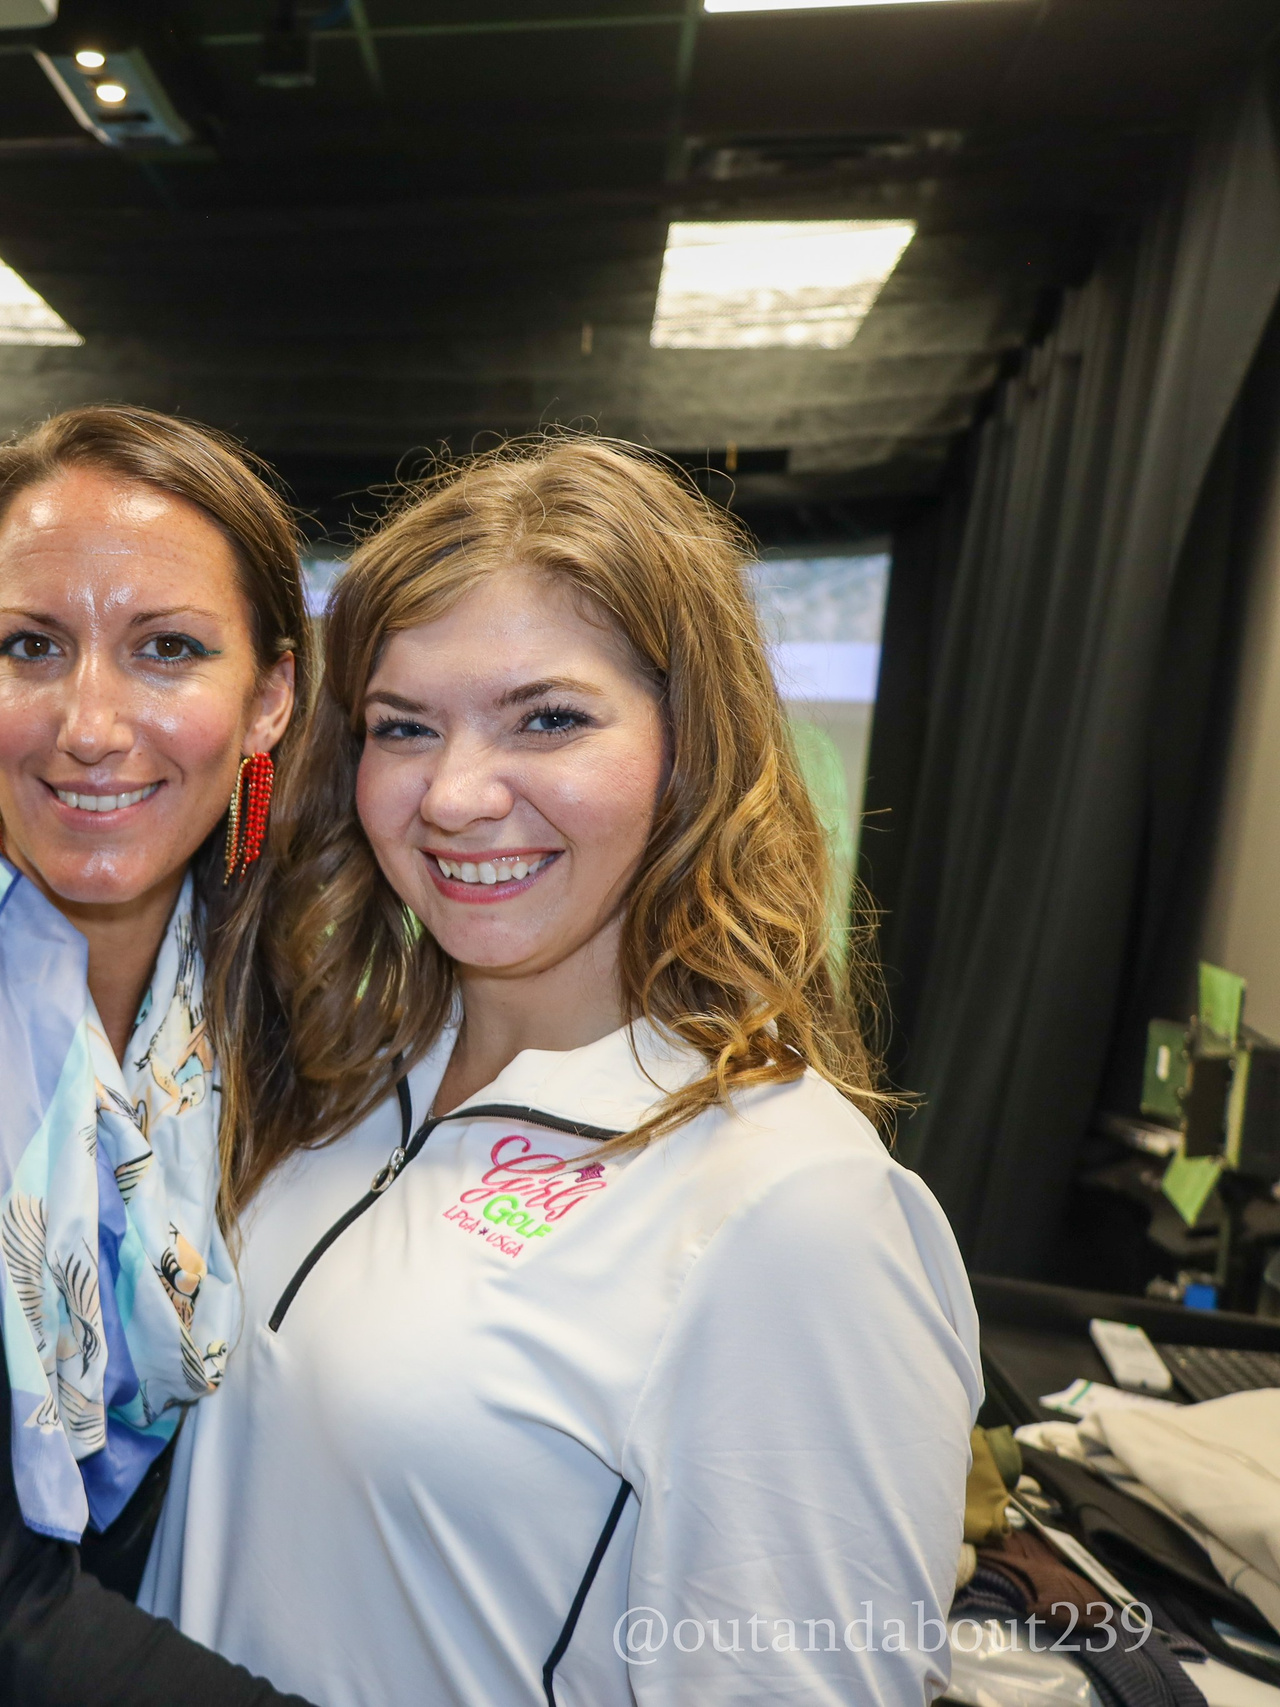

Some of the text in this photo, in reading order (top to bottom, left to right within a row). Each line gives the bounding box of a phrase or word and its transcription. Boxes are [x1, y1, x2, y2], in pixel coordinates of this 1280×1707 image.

[460, 1135, 607, 1222] Girls
[442, 1205, 524, 1258] LPGA USGA
[483, 1194, 554, 1238] GOLF
